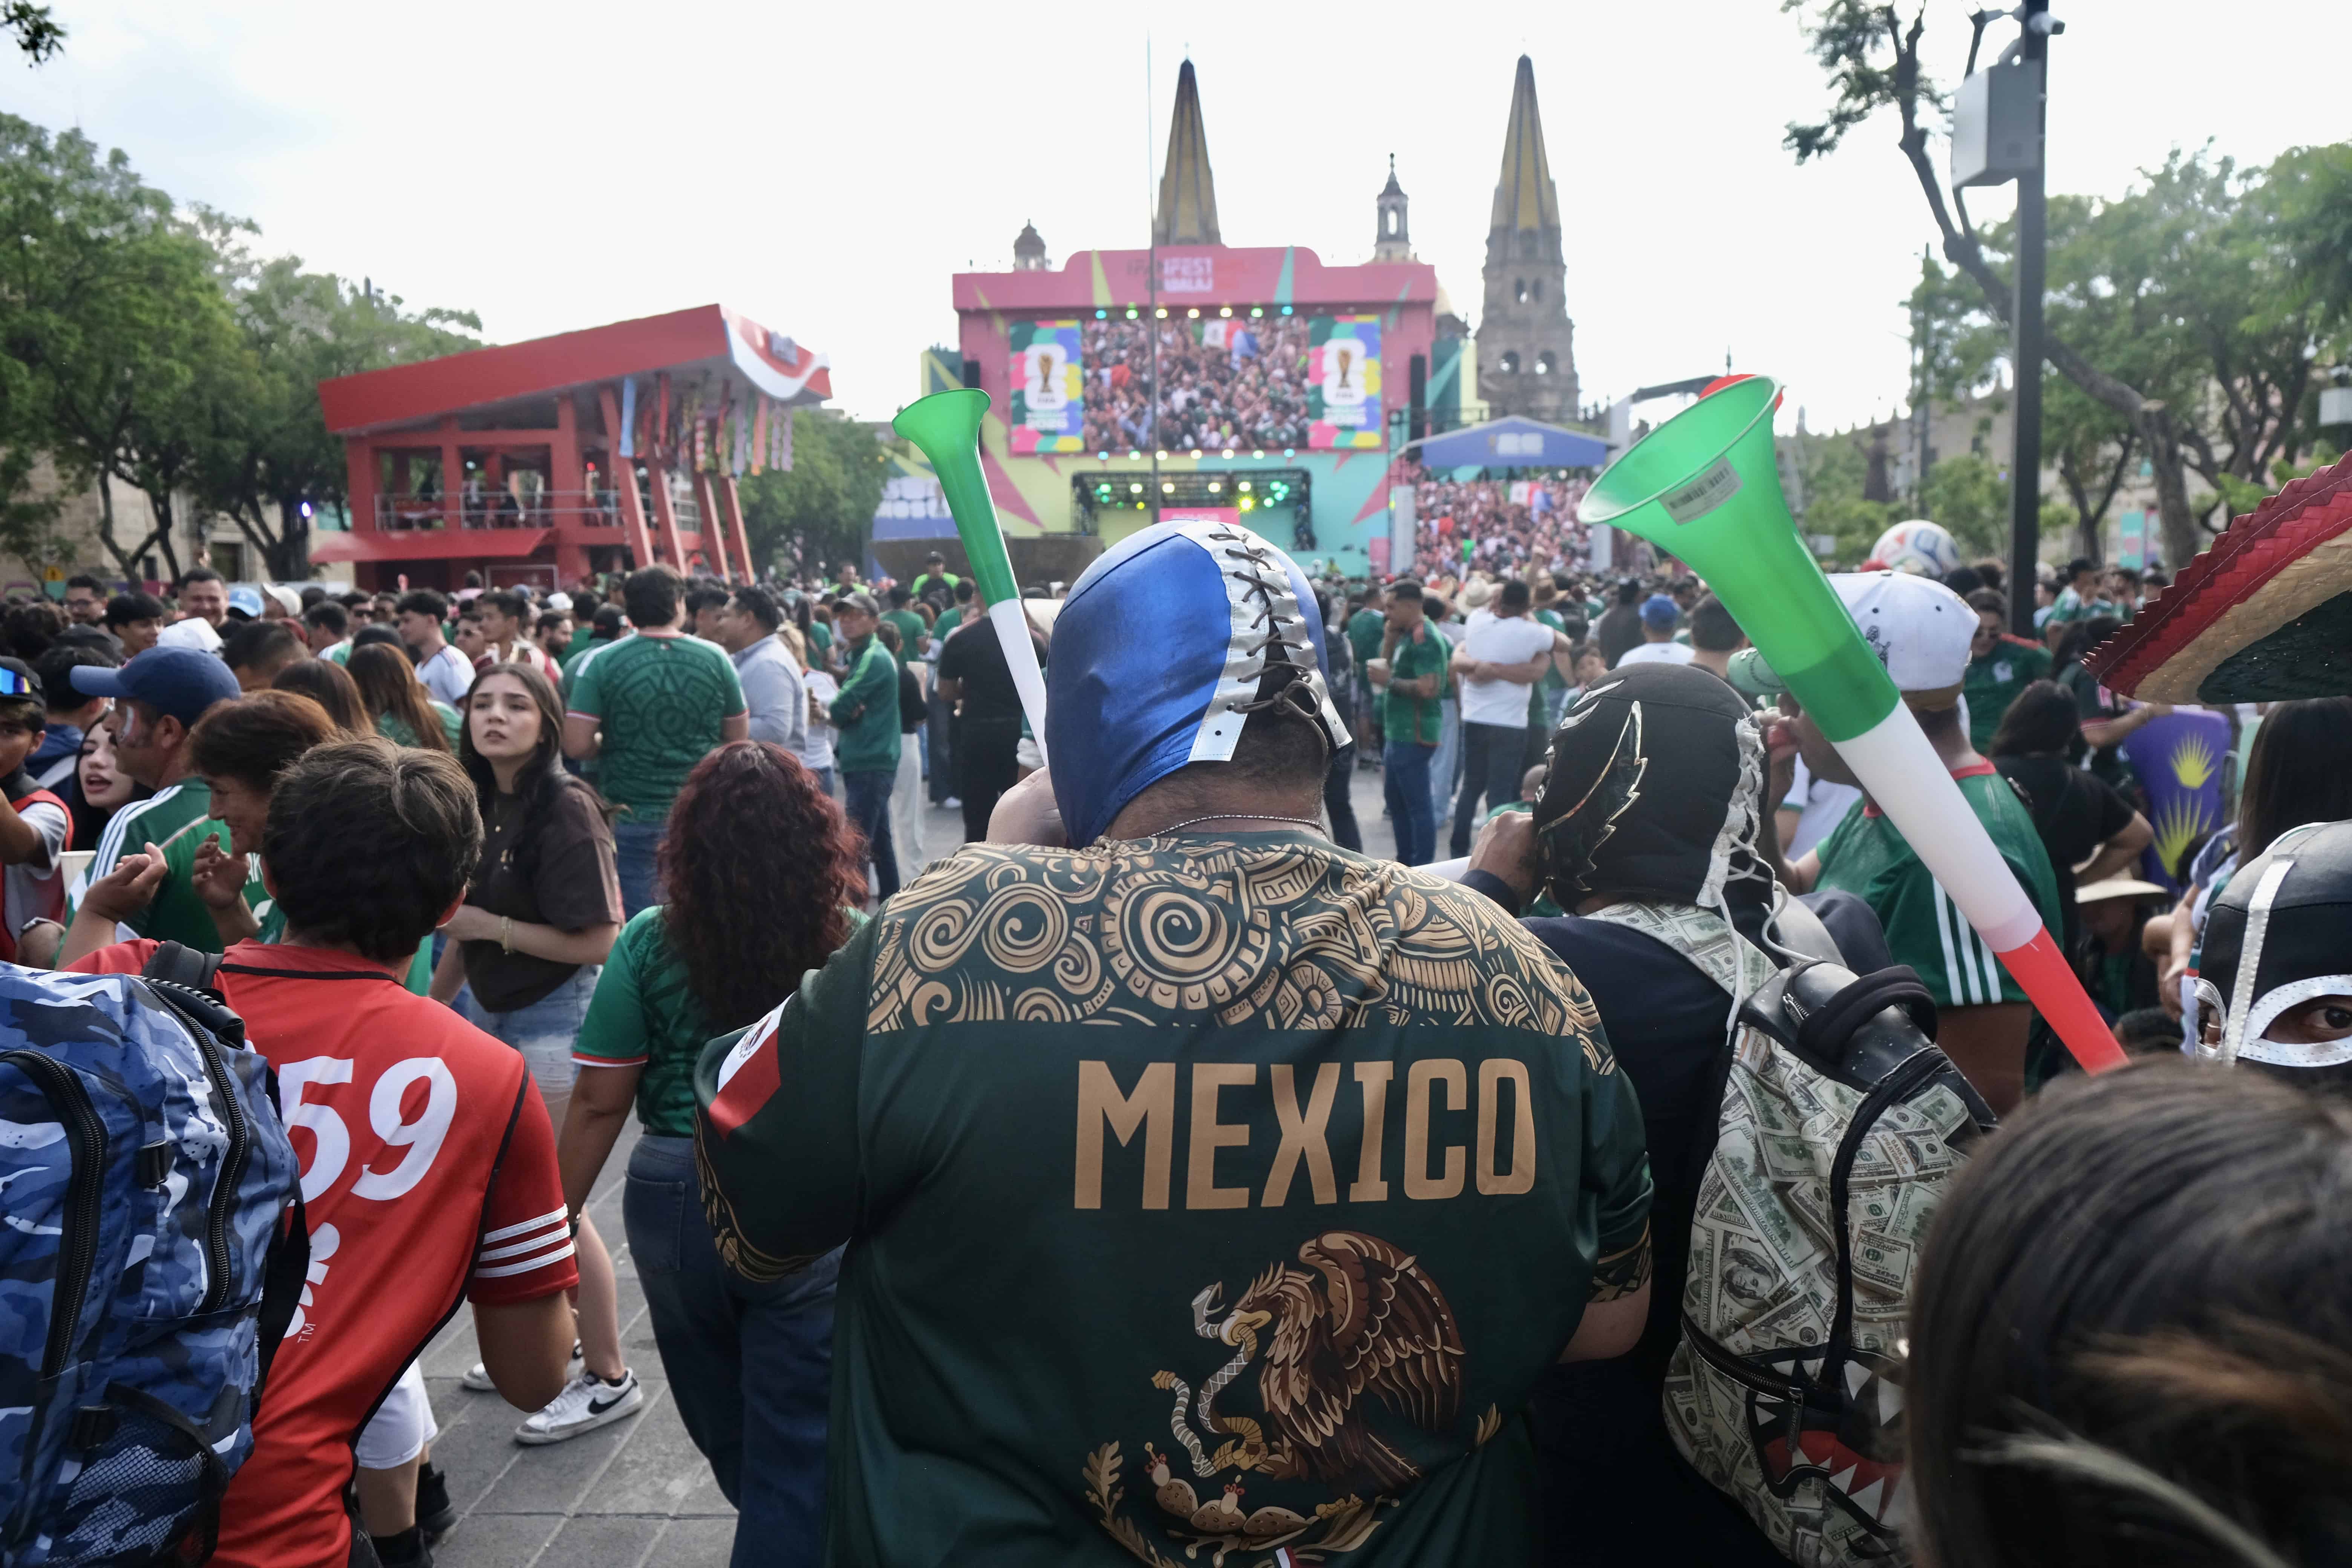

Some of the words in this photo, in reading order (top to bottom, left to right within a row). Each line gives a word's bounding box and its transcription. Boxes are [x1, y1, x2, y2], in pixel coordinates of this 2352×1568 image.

[279, 1056, 457, 1207] 59
[1074, 1058, 1536, 1210] MEXICO
[1891, 1139, 1903, 1158] BANK
[1880, 1134, 1908, 1175] SPRAYGROUND
[297, 1323, 317, 1344] TM
